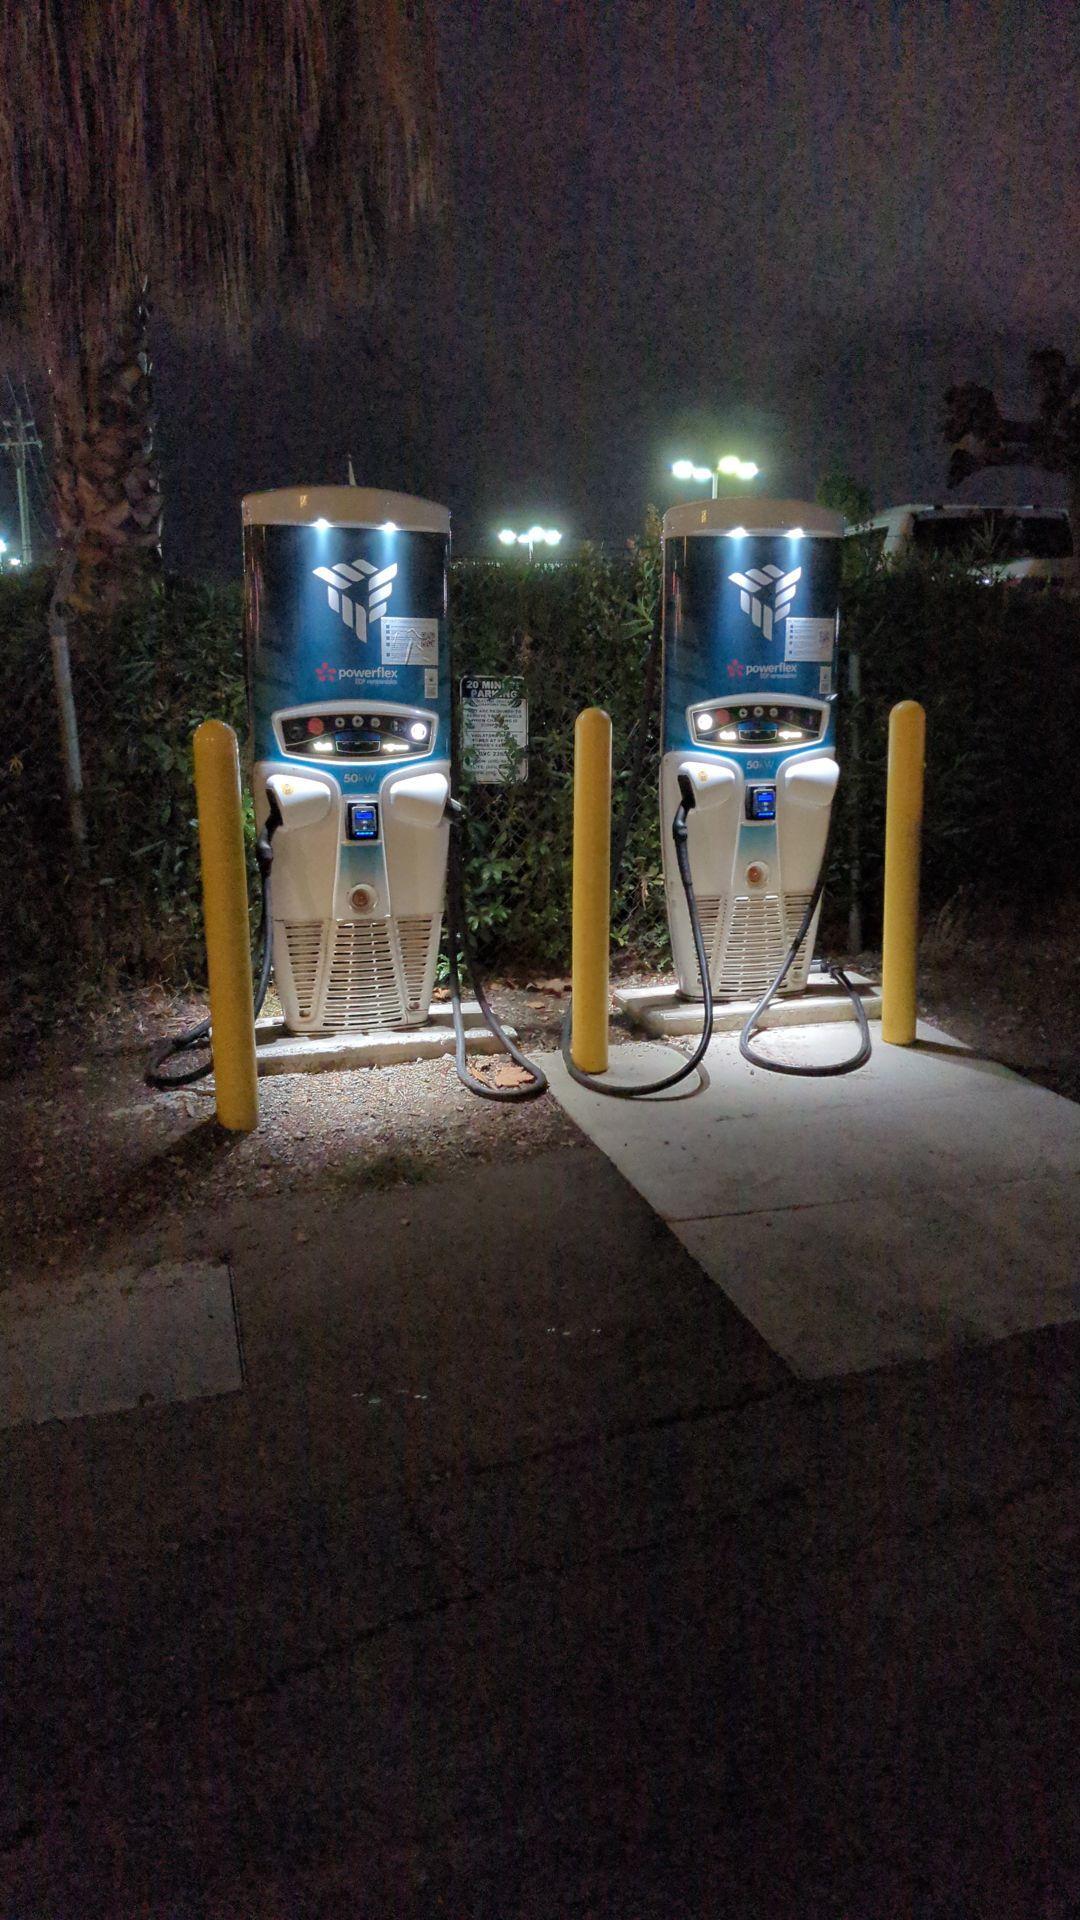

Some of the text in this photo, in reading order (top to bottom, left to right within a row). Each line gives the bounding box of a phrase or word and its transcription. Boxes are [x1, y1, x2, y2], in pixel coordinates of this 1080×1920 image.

[338, 666, 398, 680] powerflex
[746, 662, 798, 676] powerflex
[466, 680, 479, 689] 20
[471, 689, 518, 698] PARKNG
[343, 773, 376, 784] 50kW
